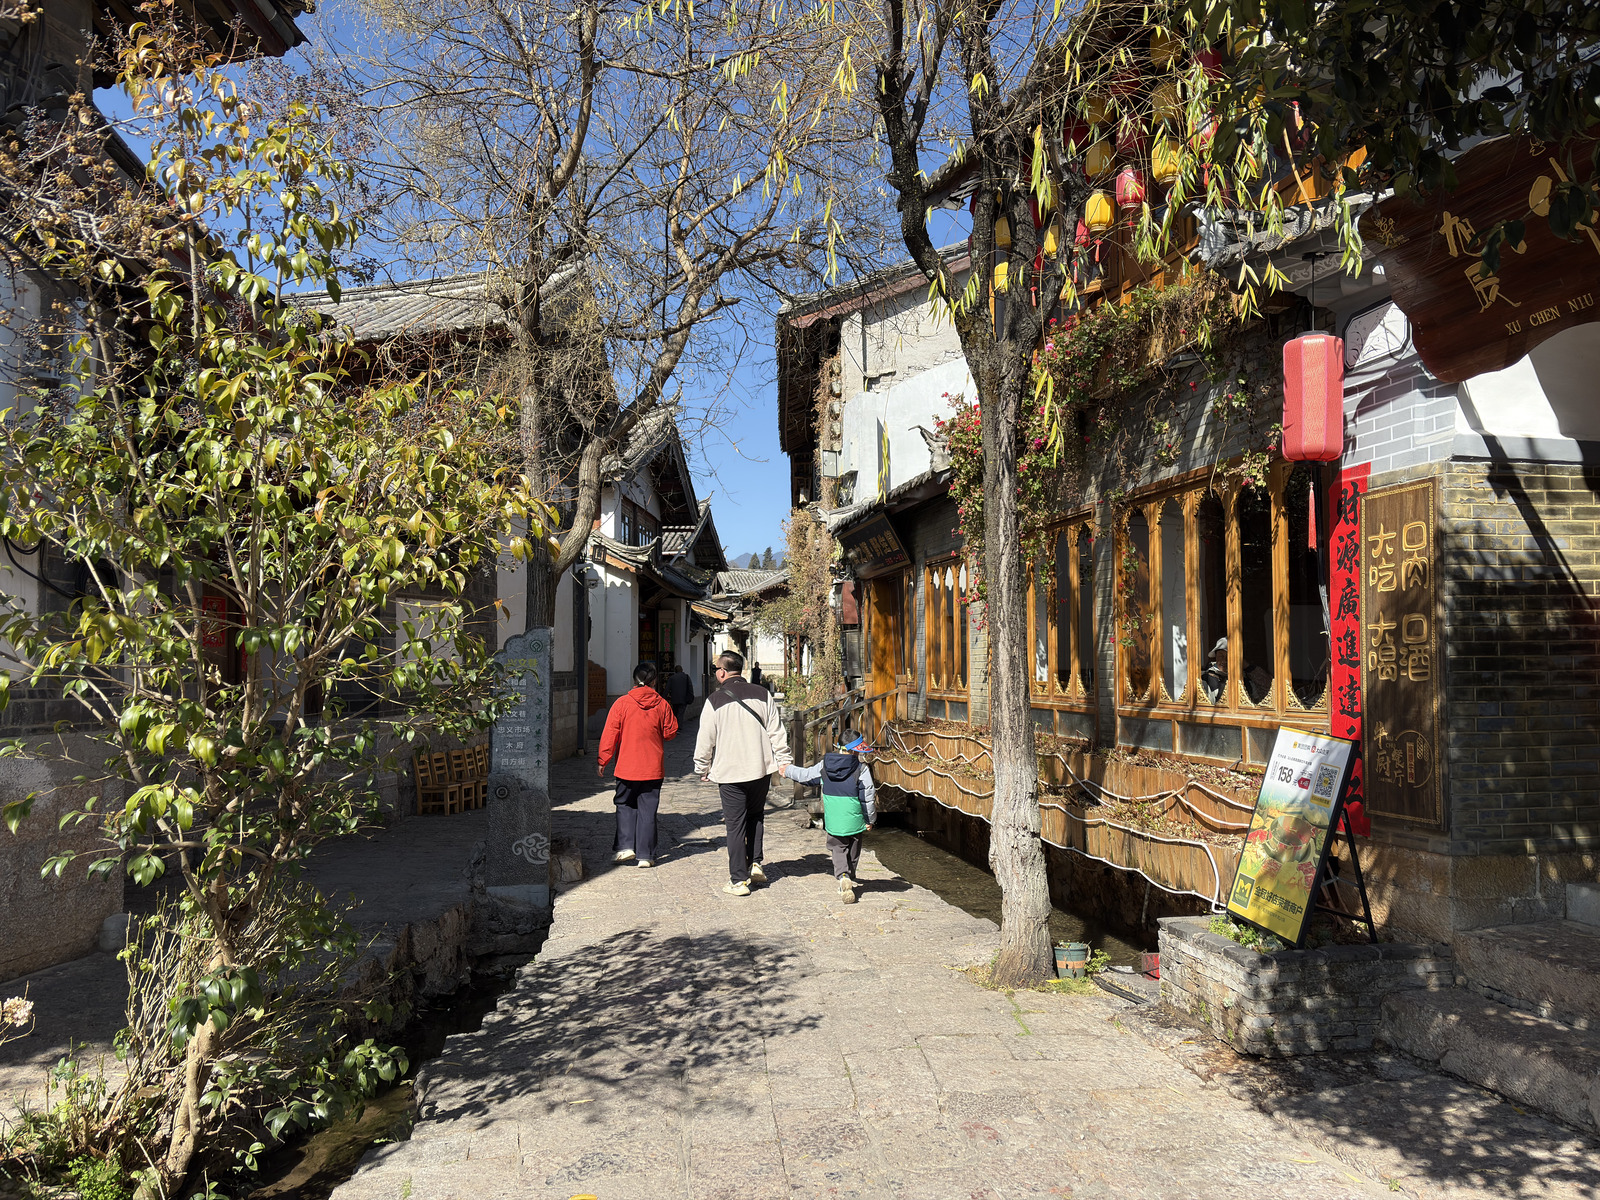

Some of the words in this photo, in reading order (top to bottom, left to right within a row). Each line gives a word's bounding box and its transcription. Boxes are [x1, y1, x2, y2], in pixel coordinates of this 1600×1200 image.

[1504, 319, 1522, 336] XU
[1529, 305, 1561, 327] CHEN
[1567, 292, 1594, 313] NIU
[497, 726, 531, 734] 忠义市场
[505, 741, 524, 749] 木府
[501, 758, 526, 766] 四方街
[1277, 765, 1294, 784] 158
